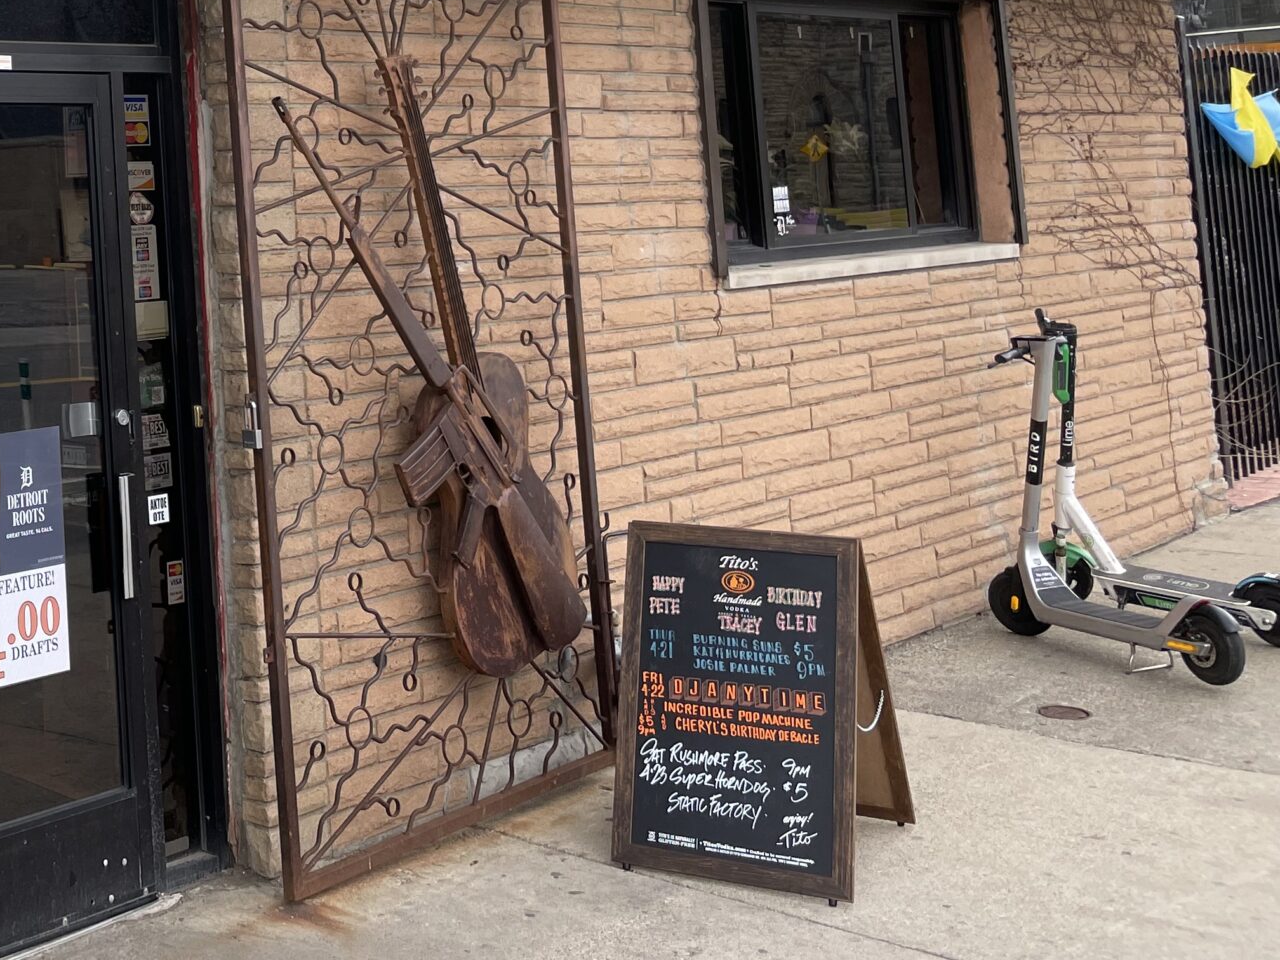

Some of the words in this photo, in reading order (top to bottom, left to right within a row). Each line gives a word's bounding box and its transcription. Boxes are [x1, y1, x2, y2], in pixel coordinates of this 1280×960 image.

[125, 103, 144, 112] VISA
[1062, 420, 1074, 447] Lime
[1028, 431, 1041, 473] BIRD
[151, 460, 169, 476] BEST
[6, 489, 48, 510] DETROIT
[12, 507, 45, 527] ROOTS
[652, 575, 685, 594] HAPPY
[767, 587, 822, 609] BIRTHDAY
[712, 592, 762, 607] Handmade
[649, 596, 681, 614] PETE
[717, 615, 762, 635] TRACEY
[775, 611, 817, 632] GLEN
[724, 605, 750, 614] VODKA
[11, 637, 59, 661] DRAFTS
[692, 633, 748, 649] BURNING
[793, 641, 814, 662] $5
[692, 645, 715, 658] KAT
[725, 648, 791, 665] HURRICANES
[642, 671, 663, 685] FRI
[692, 658, 726, 672] JOSIE
[729, 661, 776, 676] PALMER
[796, 661, 826, 680] 9PM
[663, 701, 734, 719] INCREDIBLE
[738, 710, 760, 723] POP
[761, 713, 813, 730] MACHINE
[730, 724, 776, 741] BIRTHDAY
[778, 730, 820, 745] DEBACLE
[782, 812, 814, 828] enjoy!
